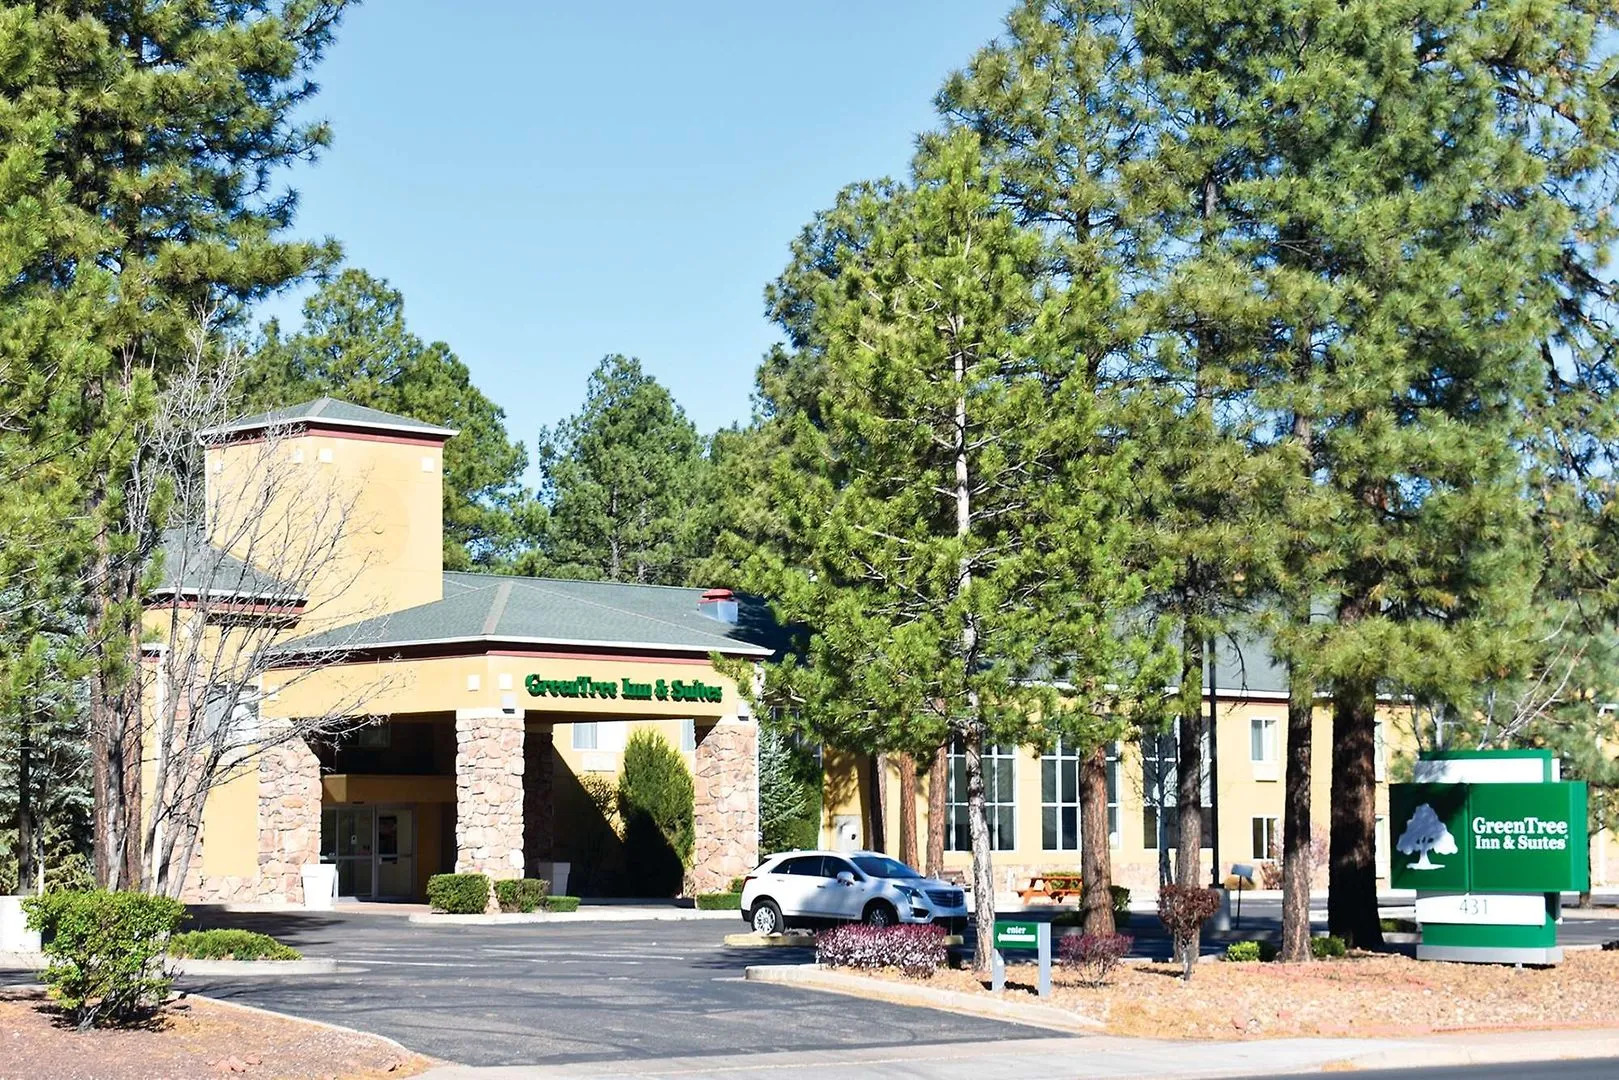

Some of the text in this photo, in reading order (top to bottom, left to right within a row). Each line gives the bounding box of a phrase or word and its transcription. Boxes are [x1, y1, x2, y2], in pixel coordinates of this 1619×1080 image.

[525, 673, 723, 703] GreenTree Inn & Suites
[1472, 817, 1568, 835] GreenTree
[1475, 835, 1567, 850] Inn & Suites
[1459, 898, 1489, 915] 431
[1006, 926, 1027, 934] enter
